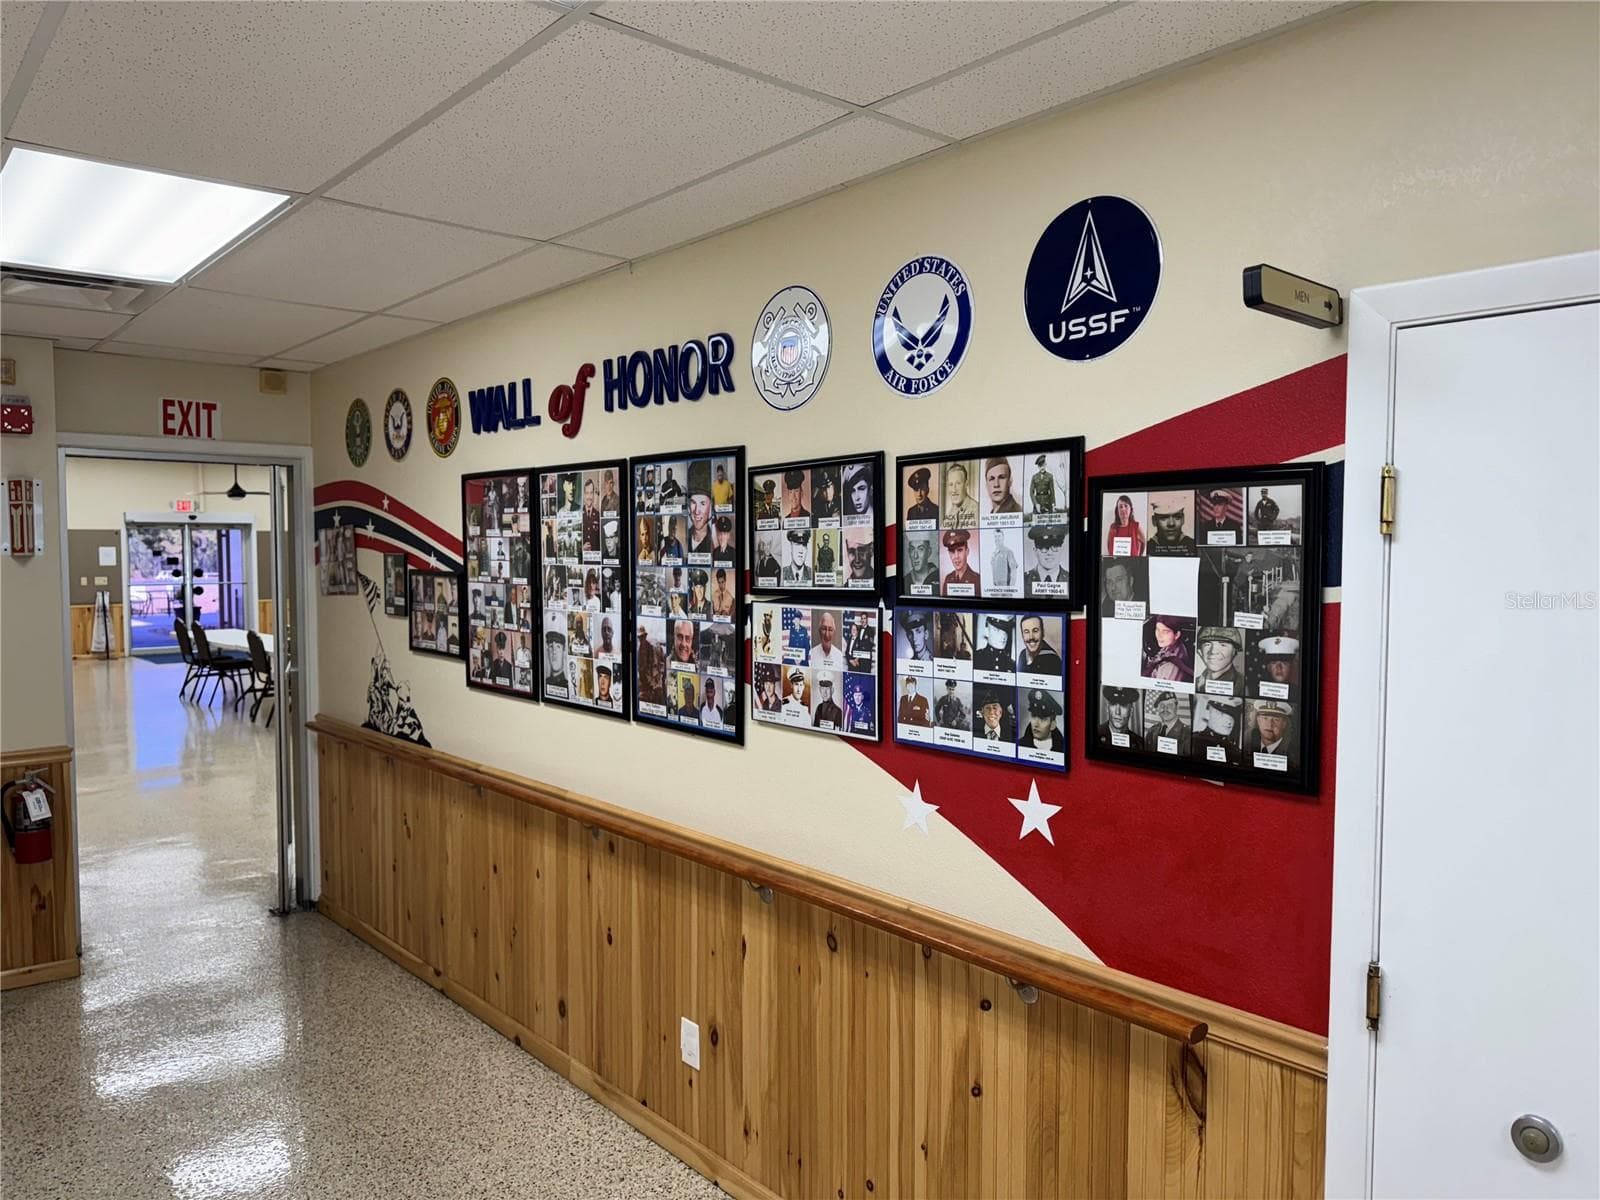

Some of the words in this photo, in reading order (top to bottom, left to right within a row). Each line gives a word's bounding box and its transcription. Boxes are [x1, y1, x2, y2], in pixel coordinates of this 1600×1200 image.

[877, 260, 920, 315] UNITED
[922, 257, 966, 298] STATES
[1294, 289, 1310, 304] MEN
[1048, 308, 1131, 344] USSF
[468, 378, 541, 435] WALL
[548, 363, 597, 439] of
[602, 332, 735, 412] HONOR
[885, 369, 907, 392] AIR
[910, 360, 955, 393] FORCE
[162, 399, 217, 438] EXIT
